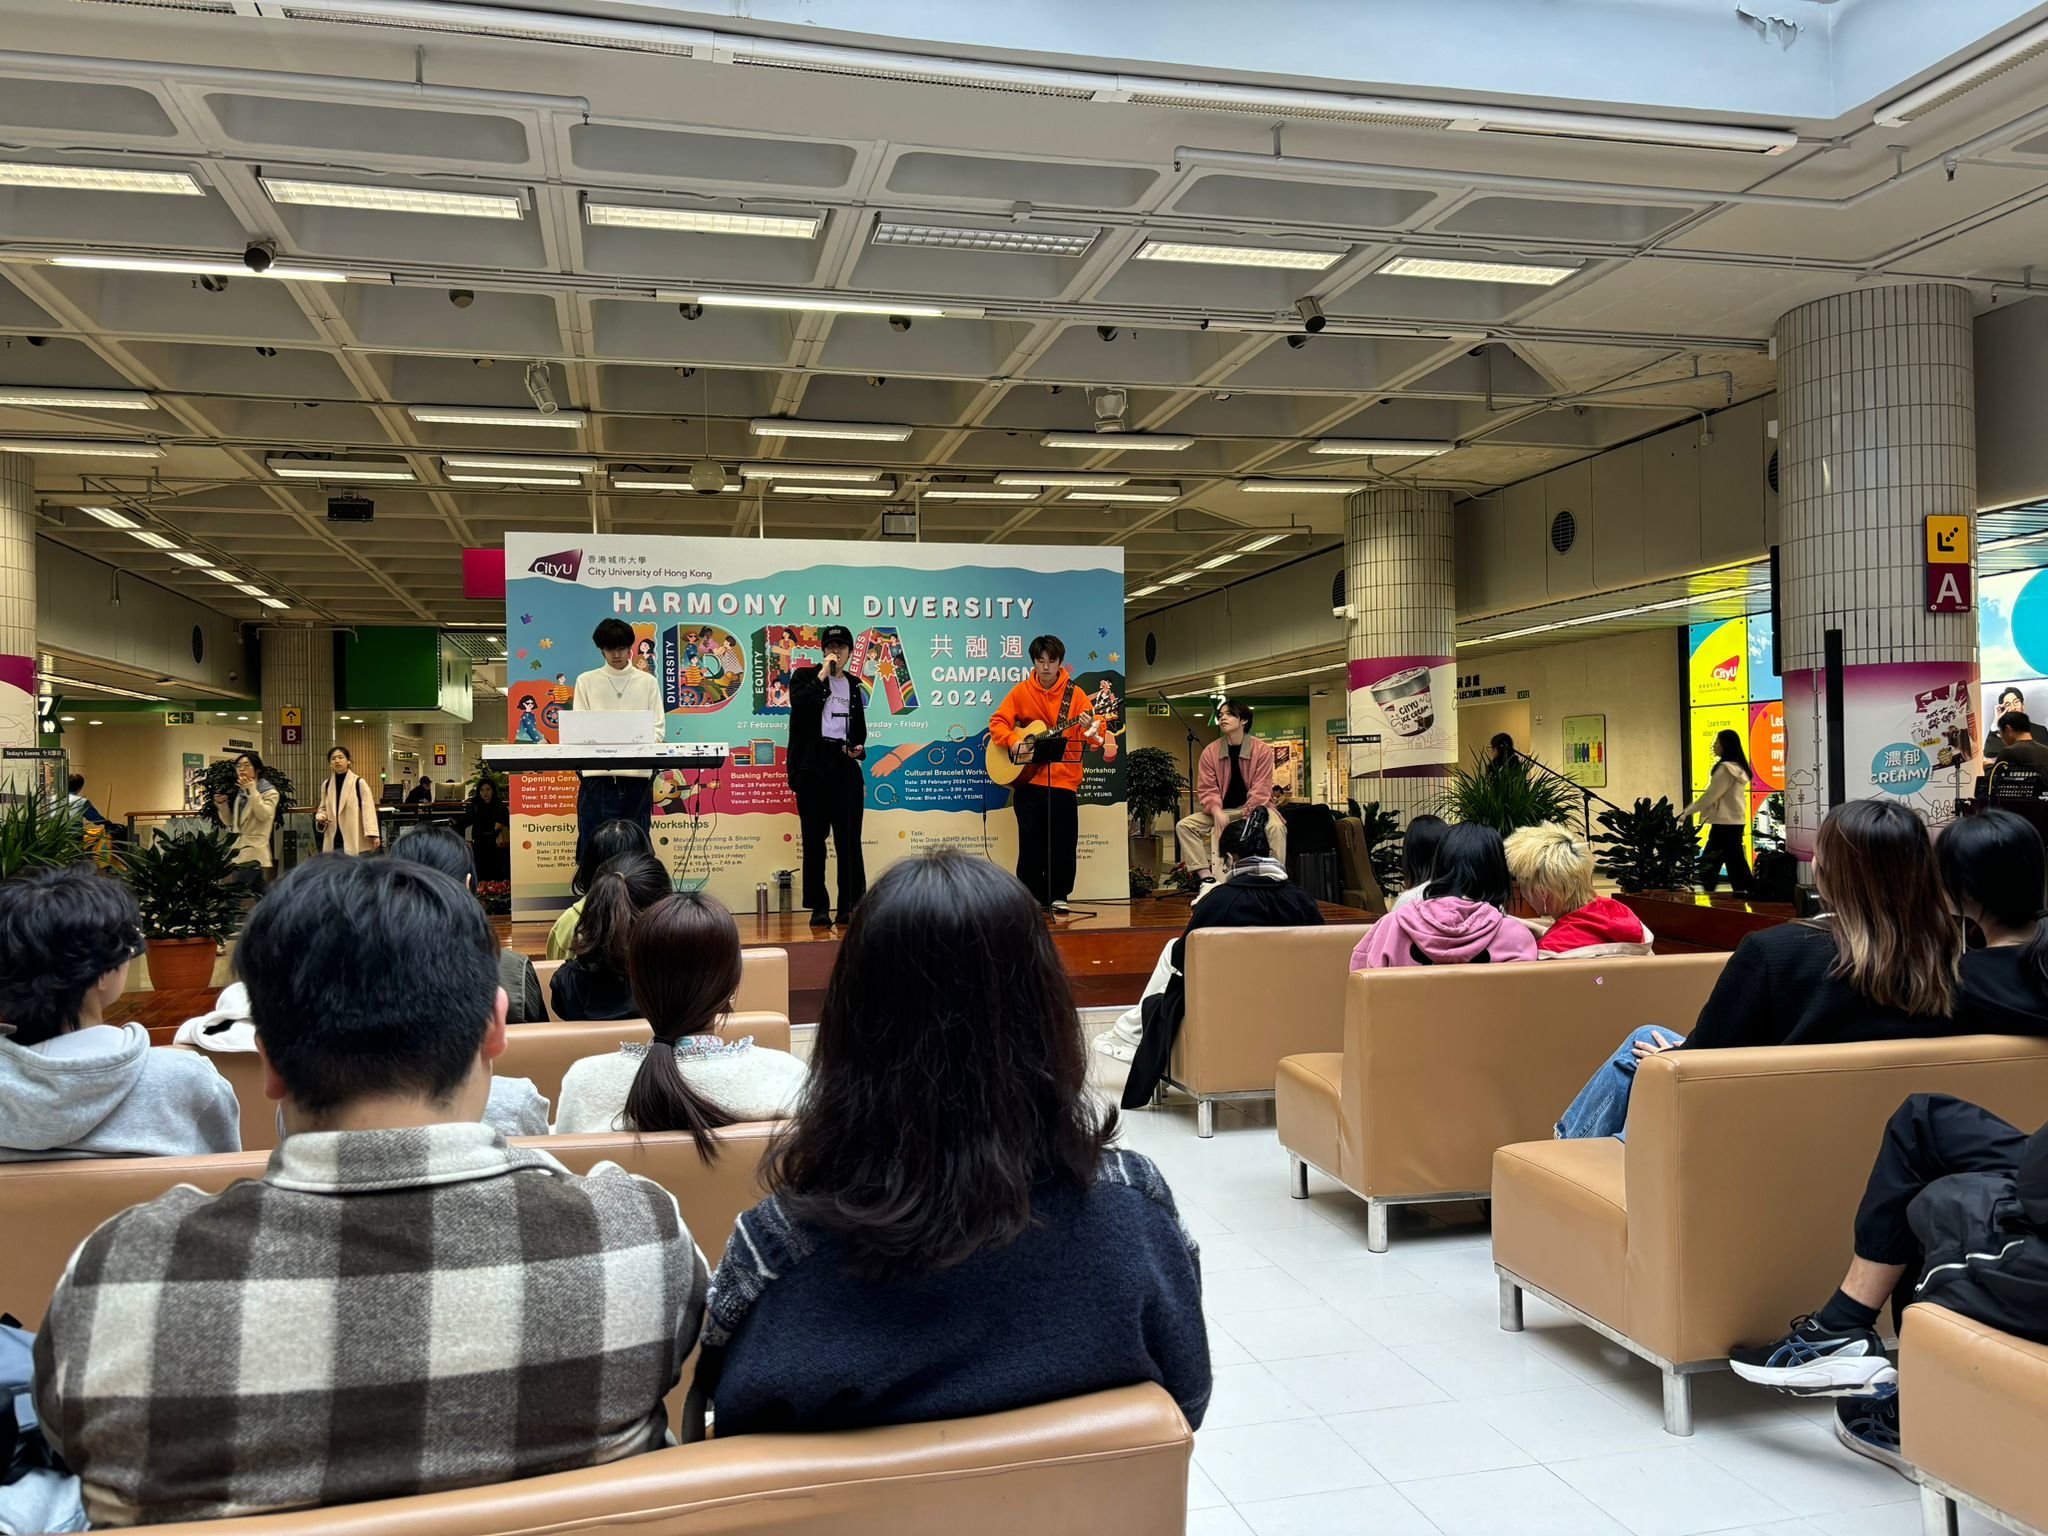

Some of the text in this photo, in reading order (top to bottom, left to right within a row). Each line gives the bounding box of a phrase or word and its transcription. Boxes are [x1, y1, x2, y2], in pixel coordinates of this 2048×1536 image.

[588, 555, 647, 565] 香港城市大學
[534, 561, 573, 577] CityU
[588, 567, 713, 580] City University of Hong Kong
[1936, 573, 1963, 604] A
[612, 591, 1034, 618] HARMONY IN DIVERSITY
[930, 634, 1023, 659] 共融週
[666, 640, 677, 704] DIVERSITY
[754, 650, 765, 695] EQUITY
[1713, 666, 1737, 680] CityU
[930, 690, 994, 706] 2024
[1459, 685, 1506, 699] LECTURE THEATRE
[750, 721, 788, 730] February
[900, 720, 929, 729] Friday)
[286, 729, 297, 741] B
[437, 756, 444, 764] B
[1884, 749, 1921, 768] 濃郁
[521, 775, 556, 783] Opening
[731, 772, 761, 780] Busking
[651, 820, 710, 830] Workshops
